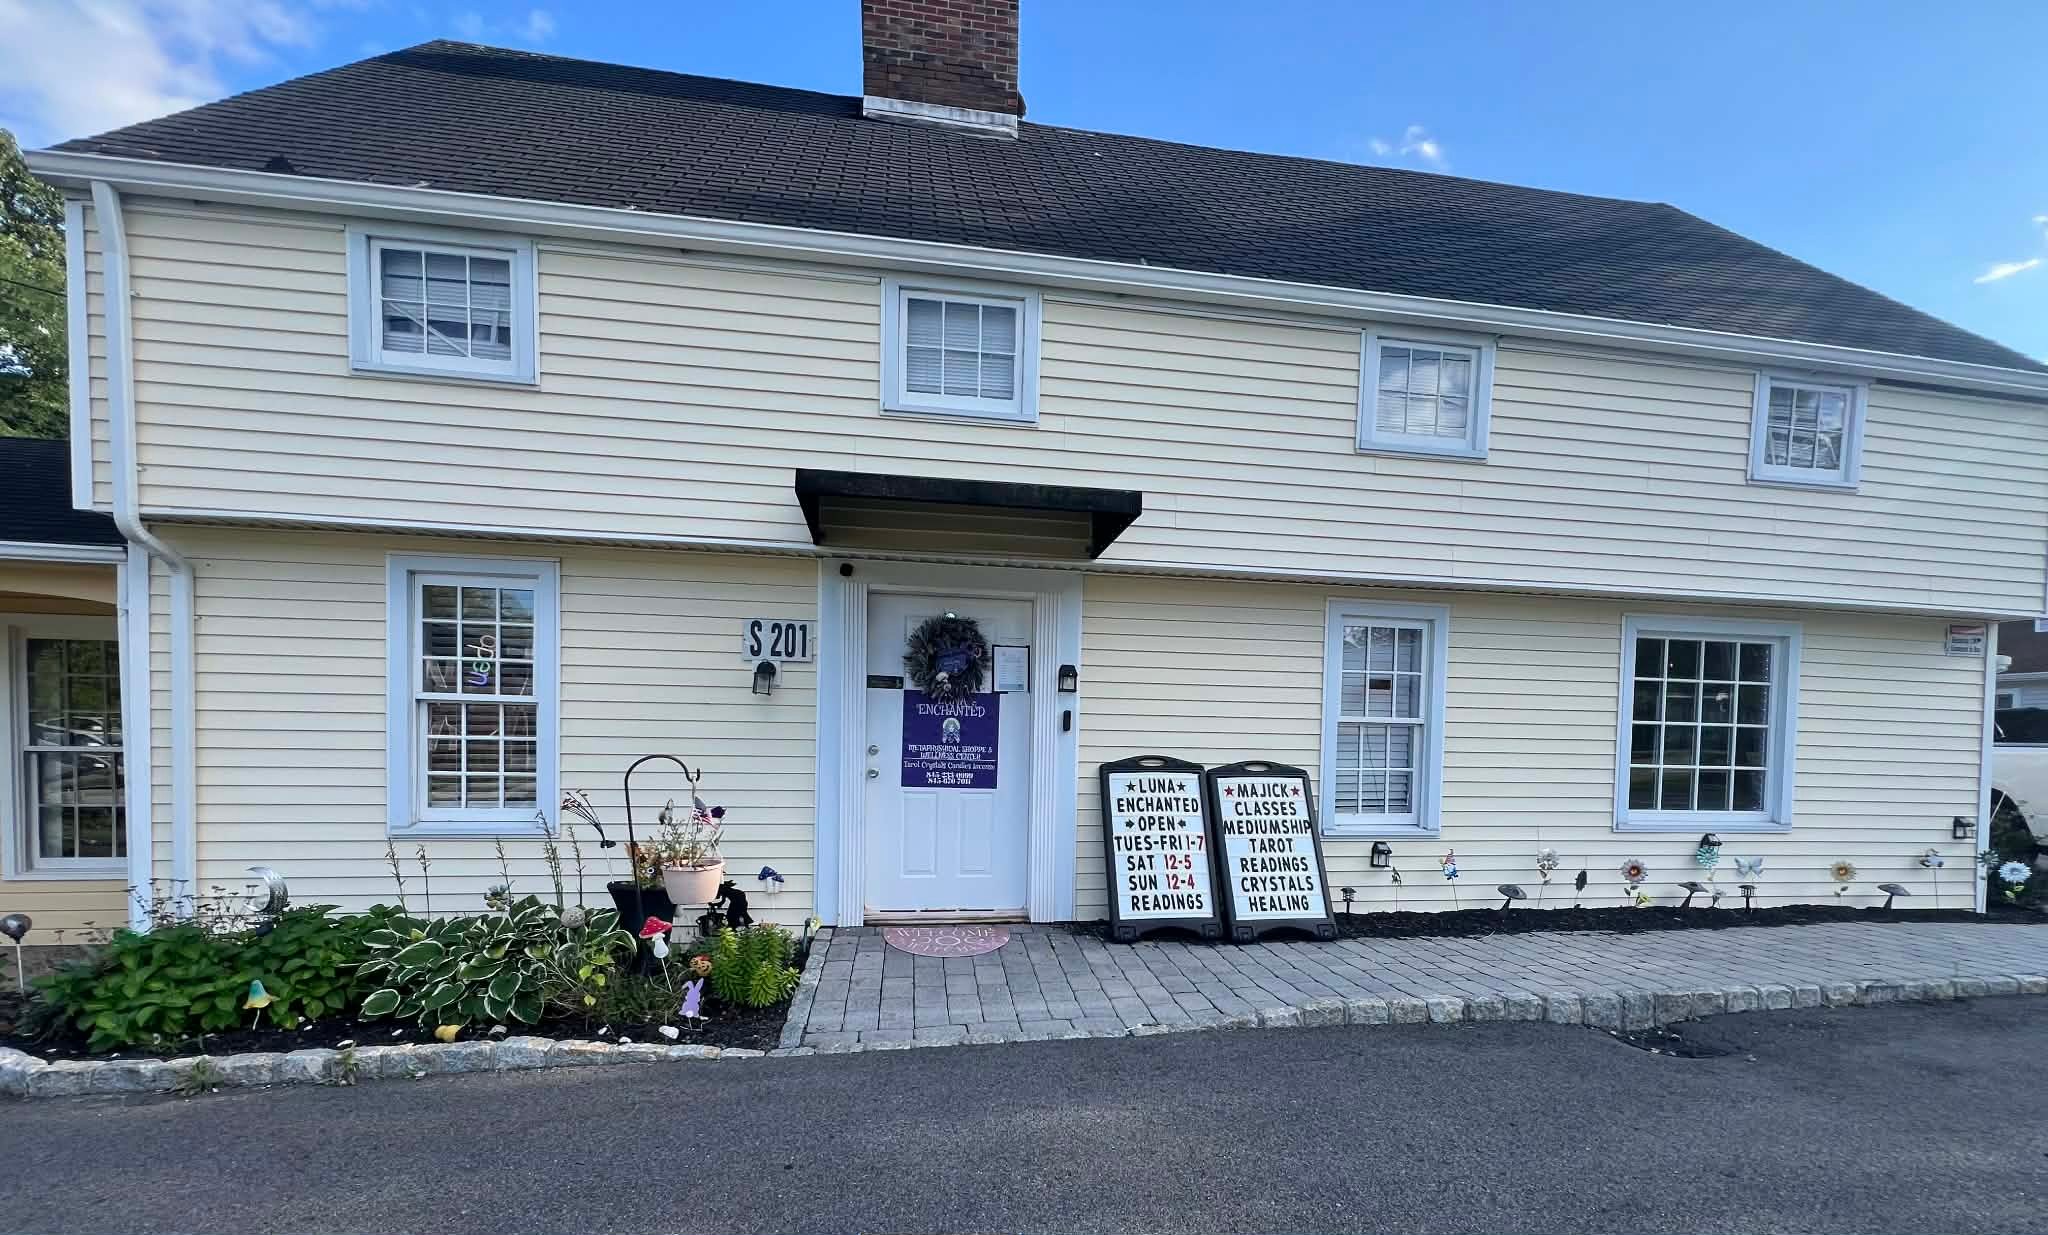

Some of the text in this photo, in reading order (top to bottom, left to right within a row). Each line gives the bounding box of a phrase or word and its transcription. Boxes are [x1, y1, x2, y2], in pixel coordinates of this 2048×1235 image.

[750, 620, 807, 657] S 201
[918, 703, 986, 717] ENCHANTED
[1138, 778, 1176, 793] LUNA
[1237, 783, 1289, 797] MAJICK
[1117, 797, 1199, 812] ENCHANTED
[1234, 801, 1297, 816] CLASSES
[1138, 816, 1175, 831] OPEN
[1223, 819, 1312, 835] MEDIUMSHIP
[1114, 835, 1204, 851] TUES-FRI 1-7
[1249, 838, 1293, 853] TAROT
[1127, 854, 1192, 871] SAT 12-5
[1240, 857, 1308, 873] READINGS
[1128, 873, 1195, 891] SUN 12-4
[1241, 875, 1314, 892] CRYSTALS
[1131, 893, 1204, 911] READINGS
[1248, 895, 1309, 912] HEALING
